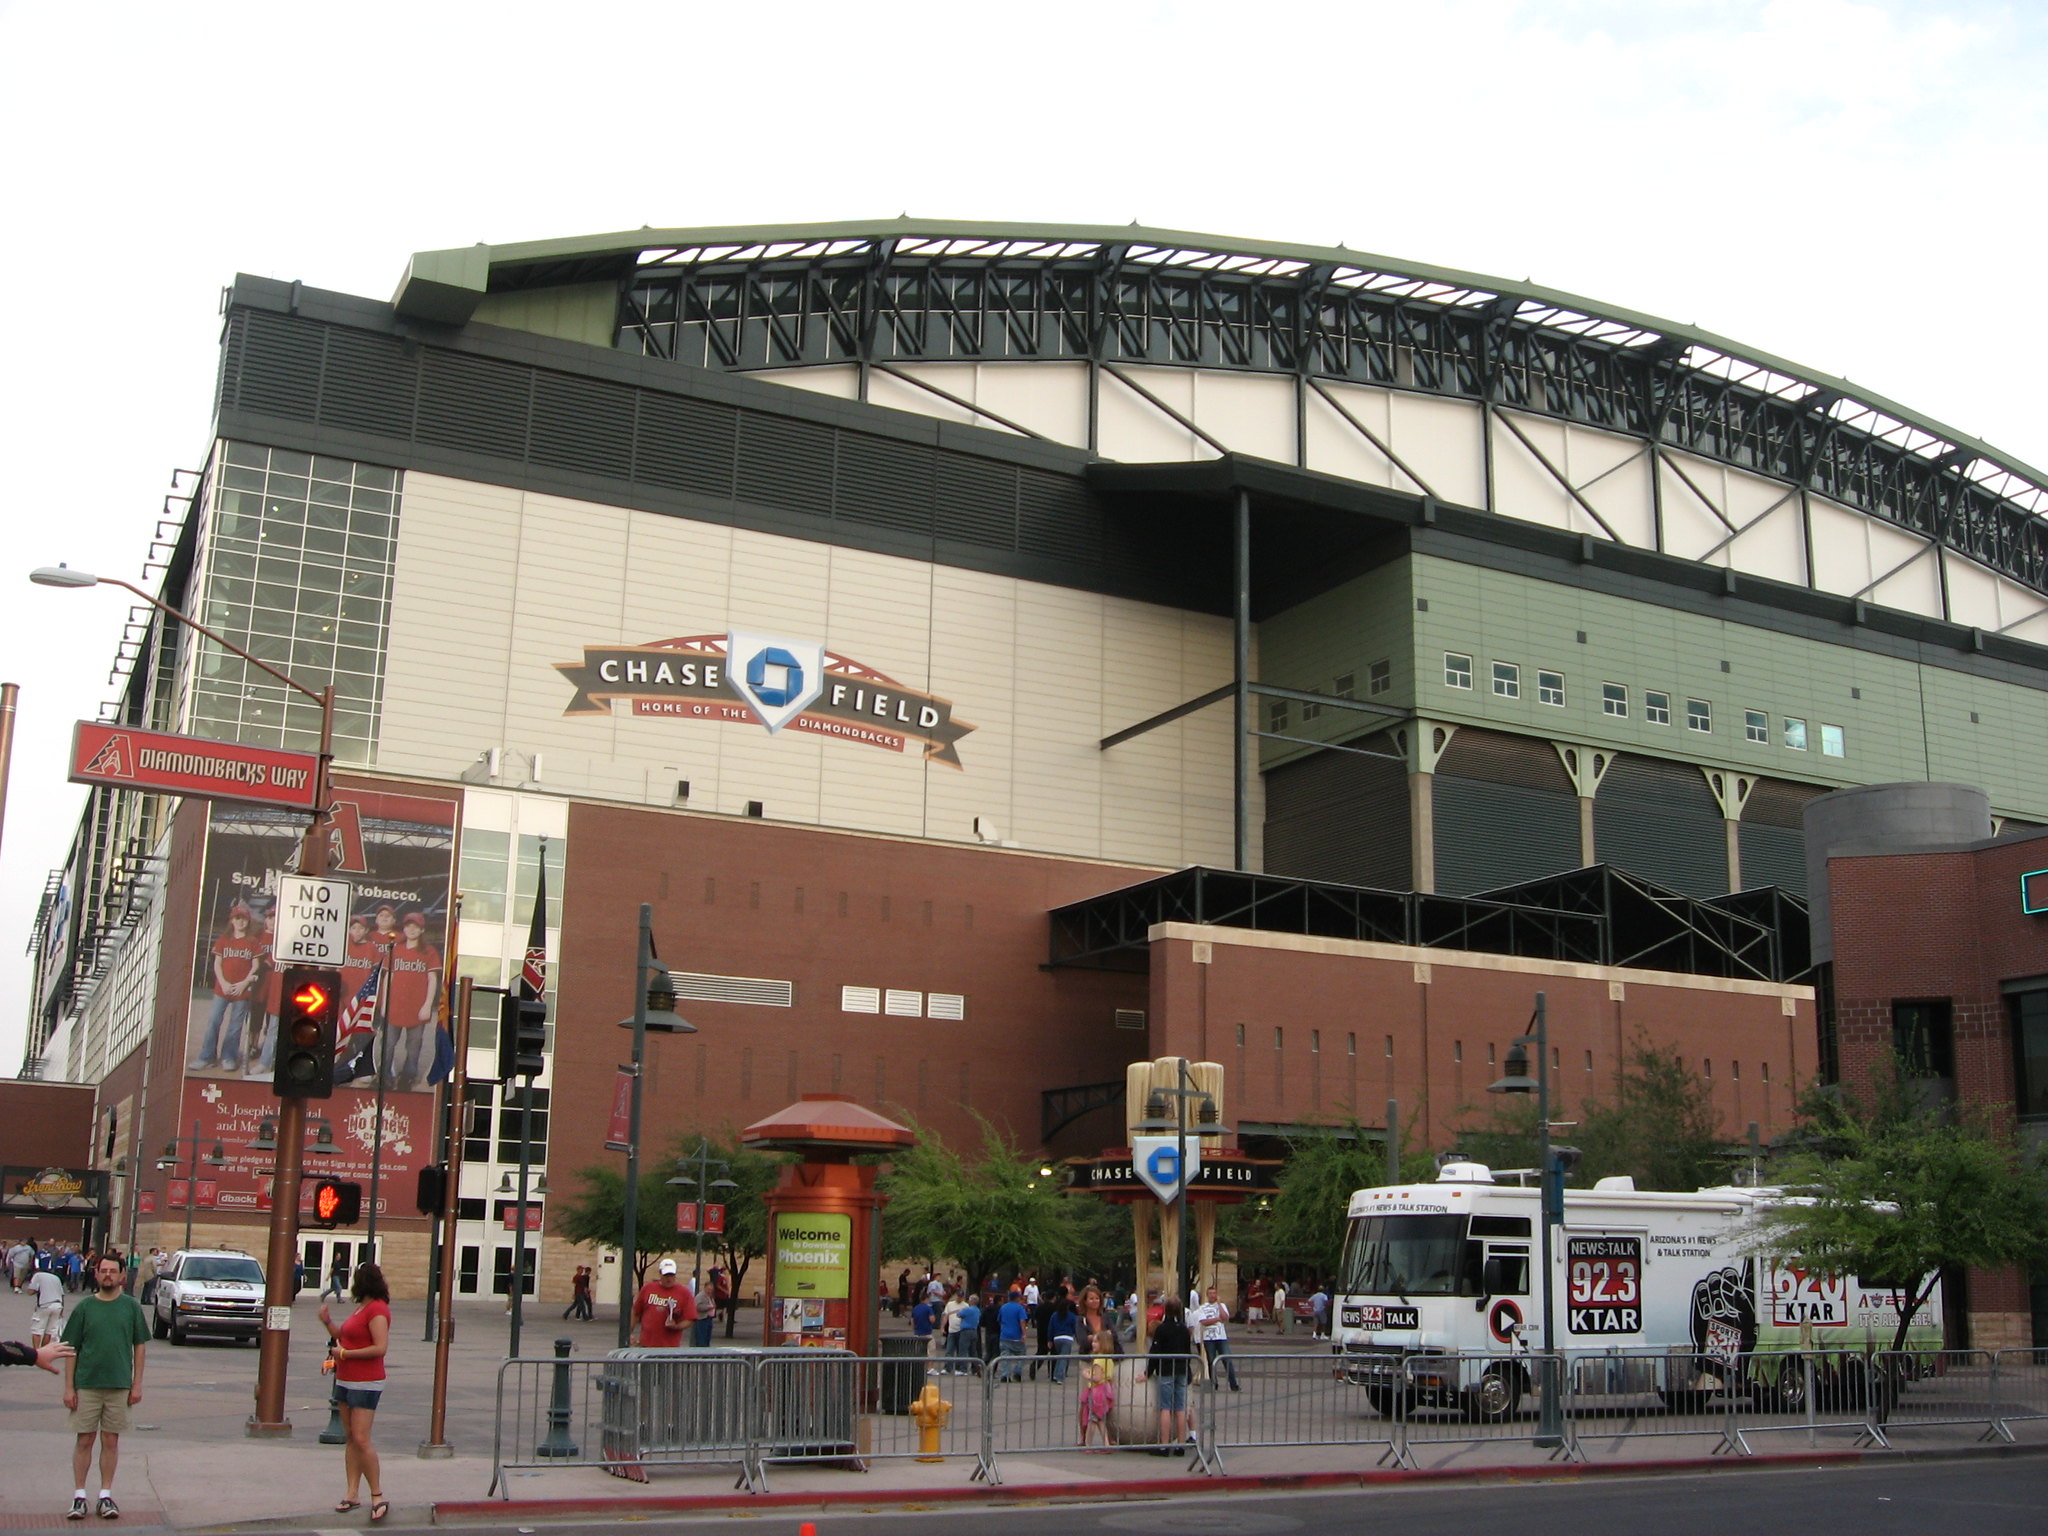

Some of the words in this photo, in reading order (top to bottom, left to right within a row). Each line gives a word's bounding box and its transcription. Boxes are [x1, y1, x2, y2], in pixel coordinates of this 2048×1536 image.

[600, 658, 719, 689] CHASE
[832, 683, 940, 730] FIELD
[641, 702, 682, 714] HOME
[692, 704, 711, 716] OF
[721, 707, 748, 719] THE
[799, 718, 900, 748] DIAMONDBACKS
[139, 748, 266, 787] DIAMONDBACKS
[271, 766, 308, 791] WAY
[231, 871, 262, 889] Say
[358, 884, 422, 903] tobacco.
[299, 884, 331, 904] NO
[289, 904, 339, 923] TURN
[300, 924, 325, 939] ON
[223, 947, 253, 960] Dbacks
[292, 941, 330, 958] RED
[394, 957, 427, 973] Dbacks
[216, 1102, 230, 1115] St.
[231, 1103, 274, 1120] Joseph's
[216, 1120, 237, 1131] and
[240, 1155, 263, 1165] pledge
[265, 1156, 273, 1164] to
[312, 1159, 329, 1167] free!
[331, 1160, 346, 1169] Sign
[347, 1162, 357, 1170] up
[1091, 1168, 1132, 1180] CHASE
[1203, 1167, 1252, 1181] FIELD
[1376, 1203, 1391, 1211] NEWS
[1398, 1203, 1415, 1211] TALK
[1416, 1203, 1448, 1214] STATION
[779, 1228, 841, 1241] Welcome
[1649, 1235, 1687, 1245] ARIZONA'S
[1687, 1236, 1696, 1245] #1
[1697, 1236, 1717, 1245] NEWS
[778, 1249, 840, 1264] Phoenix
[1571, 1242, 1635, 1256] NEWS-TALK
[1657, 1248, 1663, 1257] &
[1663, 1248, 1681, 1257] TALK
[1681, 1248, 1711, 1258] STATION
[1572, 1261, 1636, 1303] 92.3
[1342, 1310, 1360, 1323] NEWS
[1385, 1312, 1415, 1325] TALK
[1571, 1308, 1638, 1331] KTAR
[1785, 1302, 1834, 1321] KTAR
[1859, 1311, 1880, 1327] IT'S
[1909, 1312, 1933, 1328] ERE!
[1362, 1322, 1383, 1330] KTAR
[1710, 1322, 1740, 1340] SPORTS
